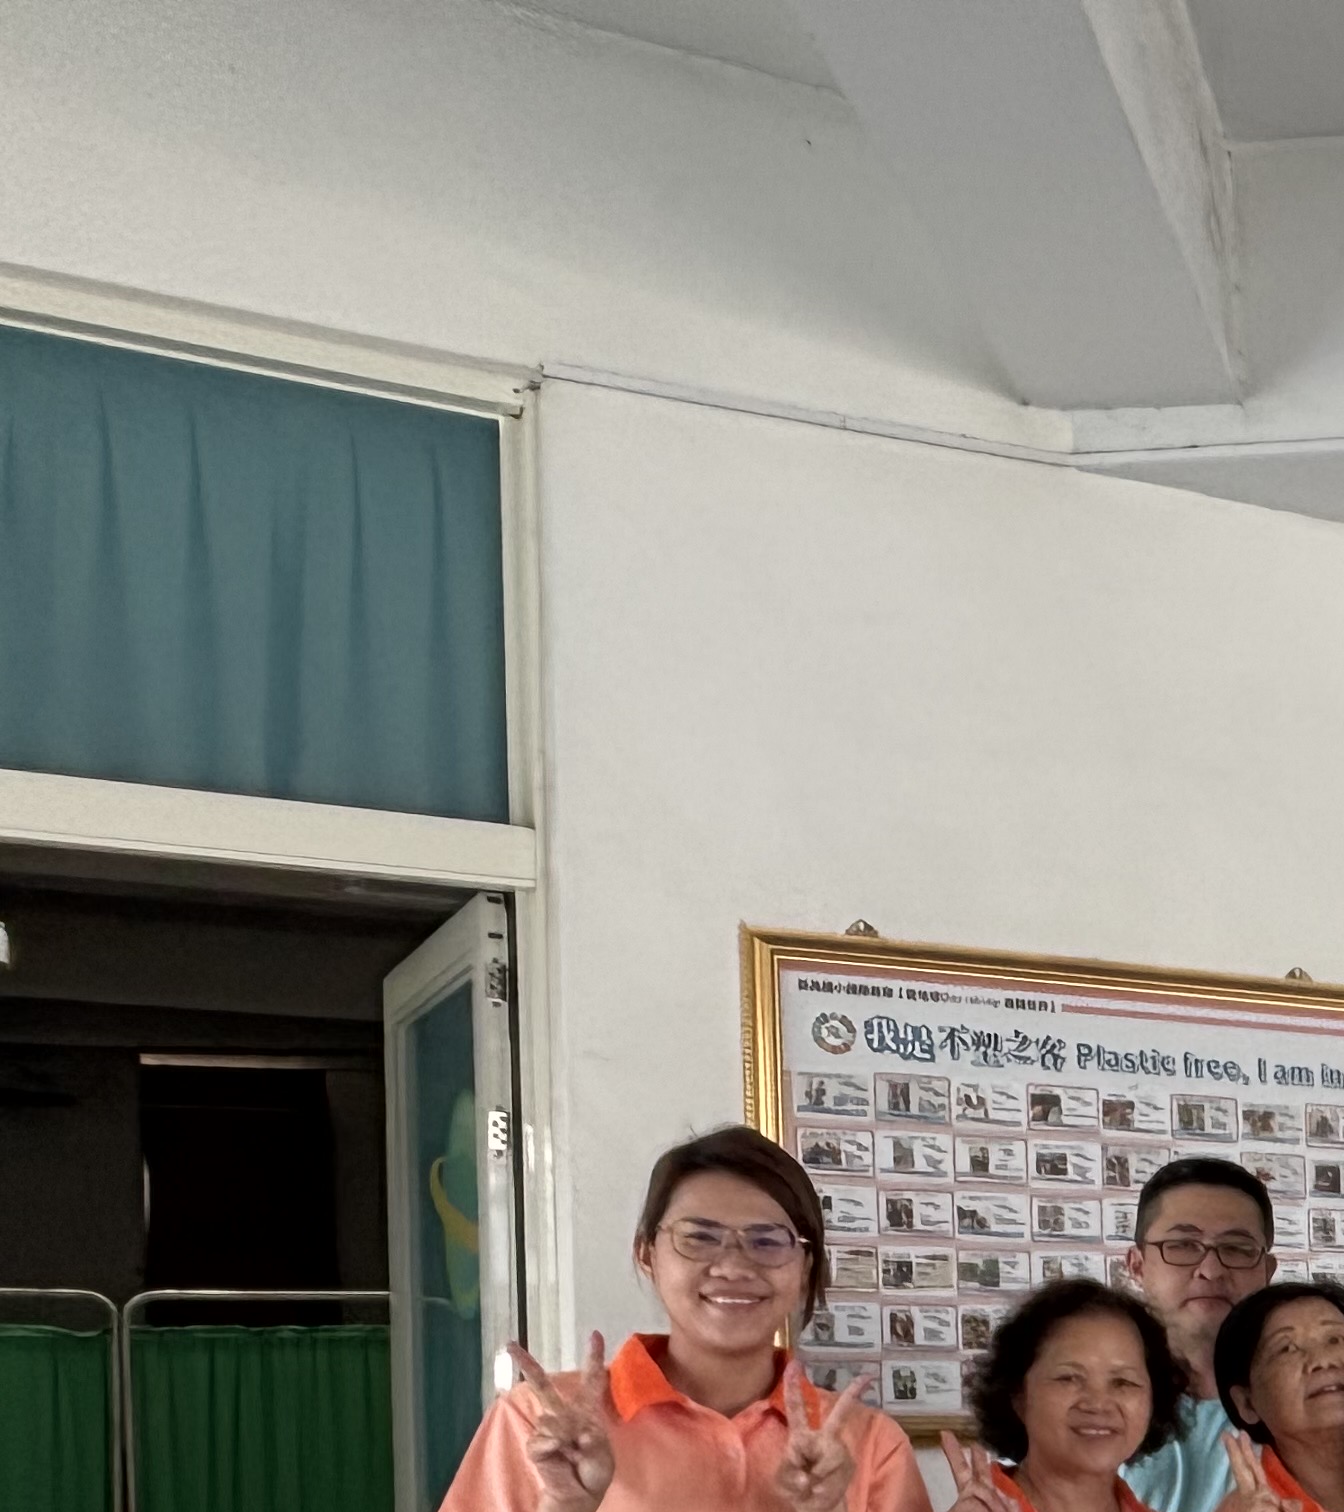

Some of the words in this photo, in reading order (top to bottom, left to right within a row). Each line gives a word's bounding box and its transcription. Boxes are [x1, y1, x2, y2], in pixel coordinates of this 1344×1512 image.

[1076, 1042, 1176, 1076] Plastic
[1257, 1057, 1267, 1084] I
[1273, 1063, 1315, 1088] am
